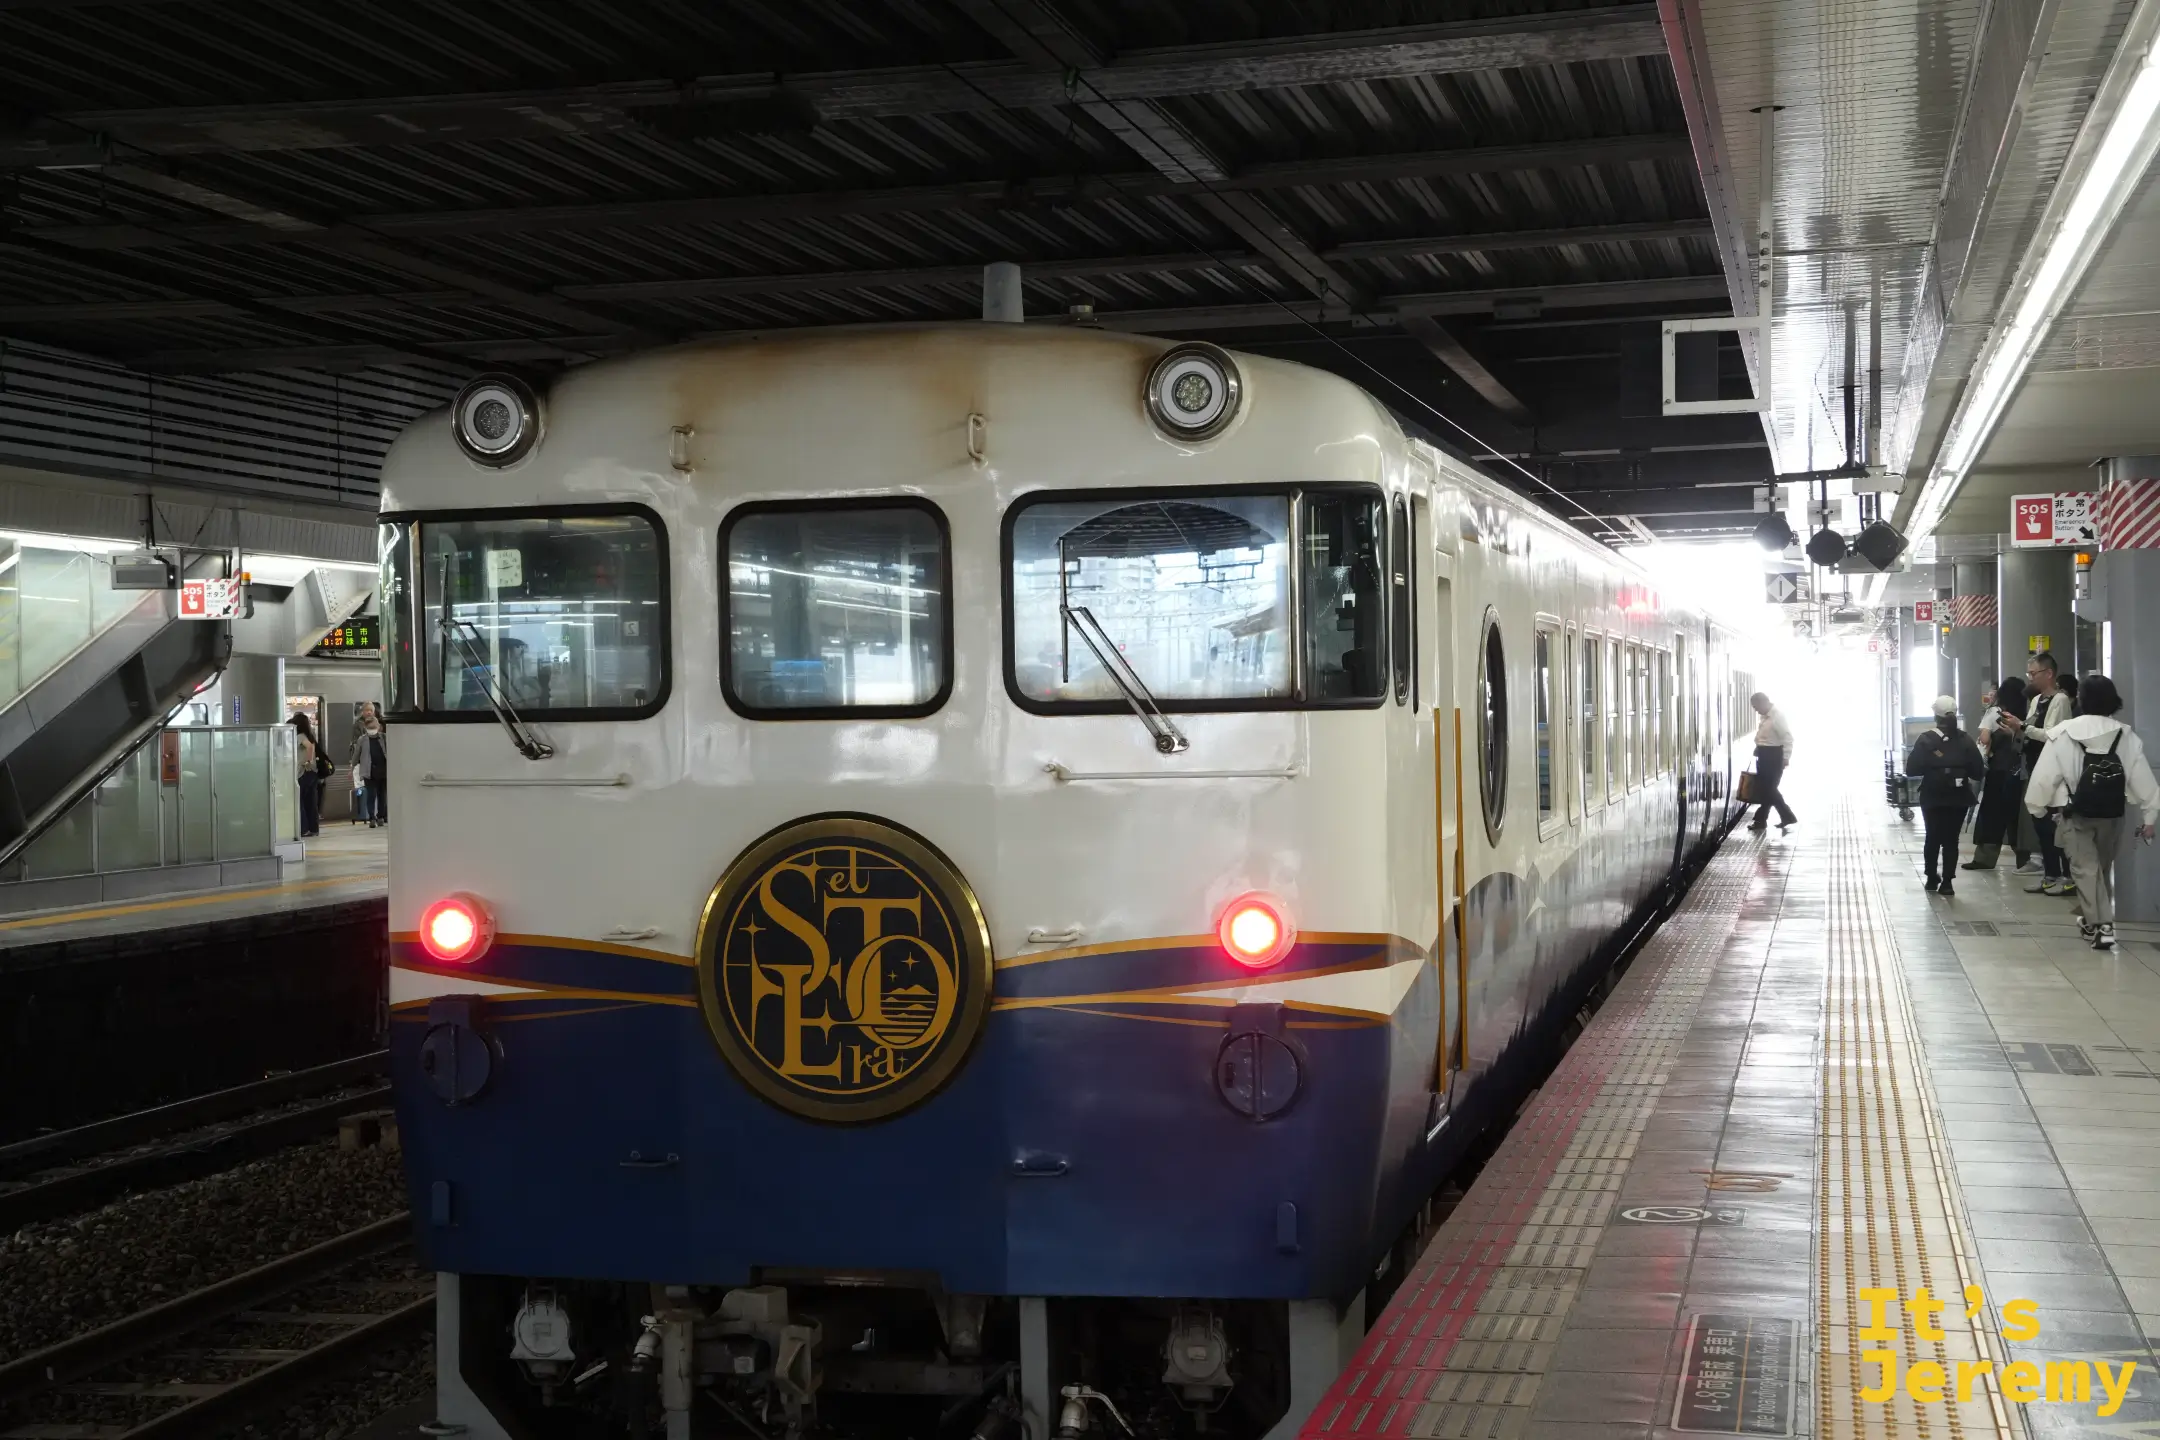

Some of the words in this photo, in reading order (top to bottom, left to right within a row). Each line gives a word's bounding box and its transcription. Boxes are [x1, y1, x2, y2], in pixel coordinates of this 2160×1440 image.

[2055, 499, 2085, 508] 非常
[2020, 504, 2048, 515] SOS
[2055, 509, 2085, 518] ボタン
[183, 587, 203, 595] SOS
